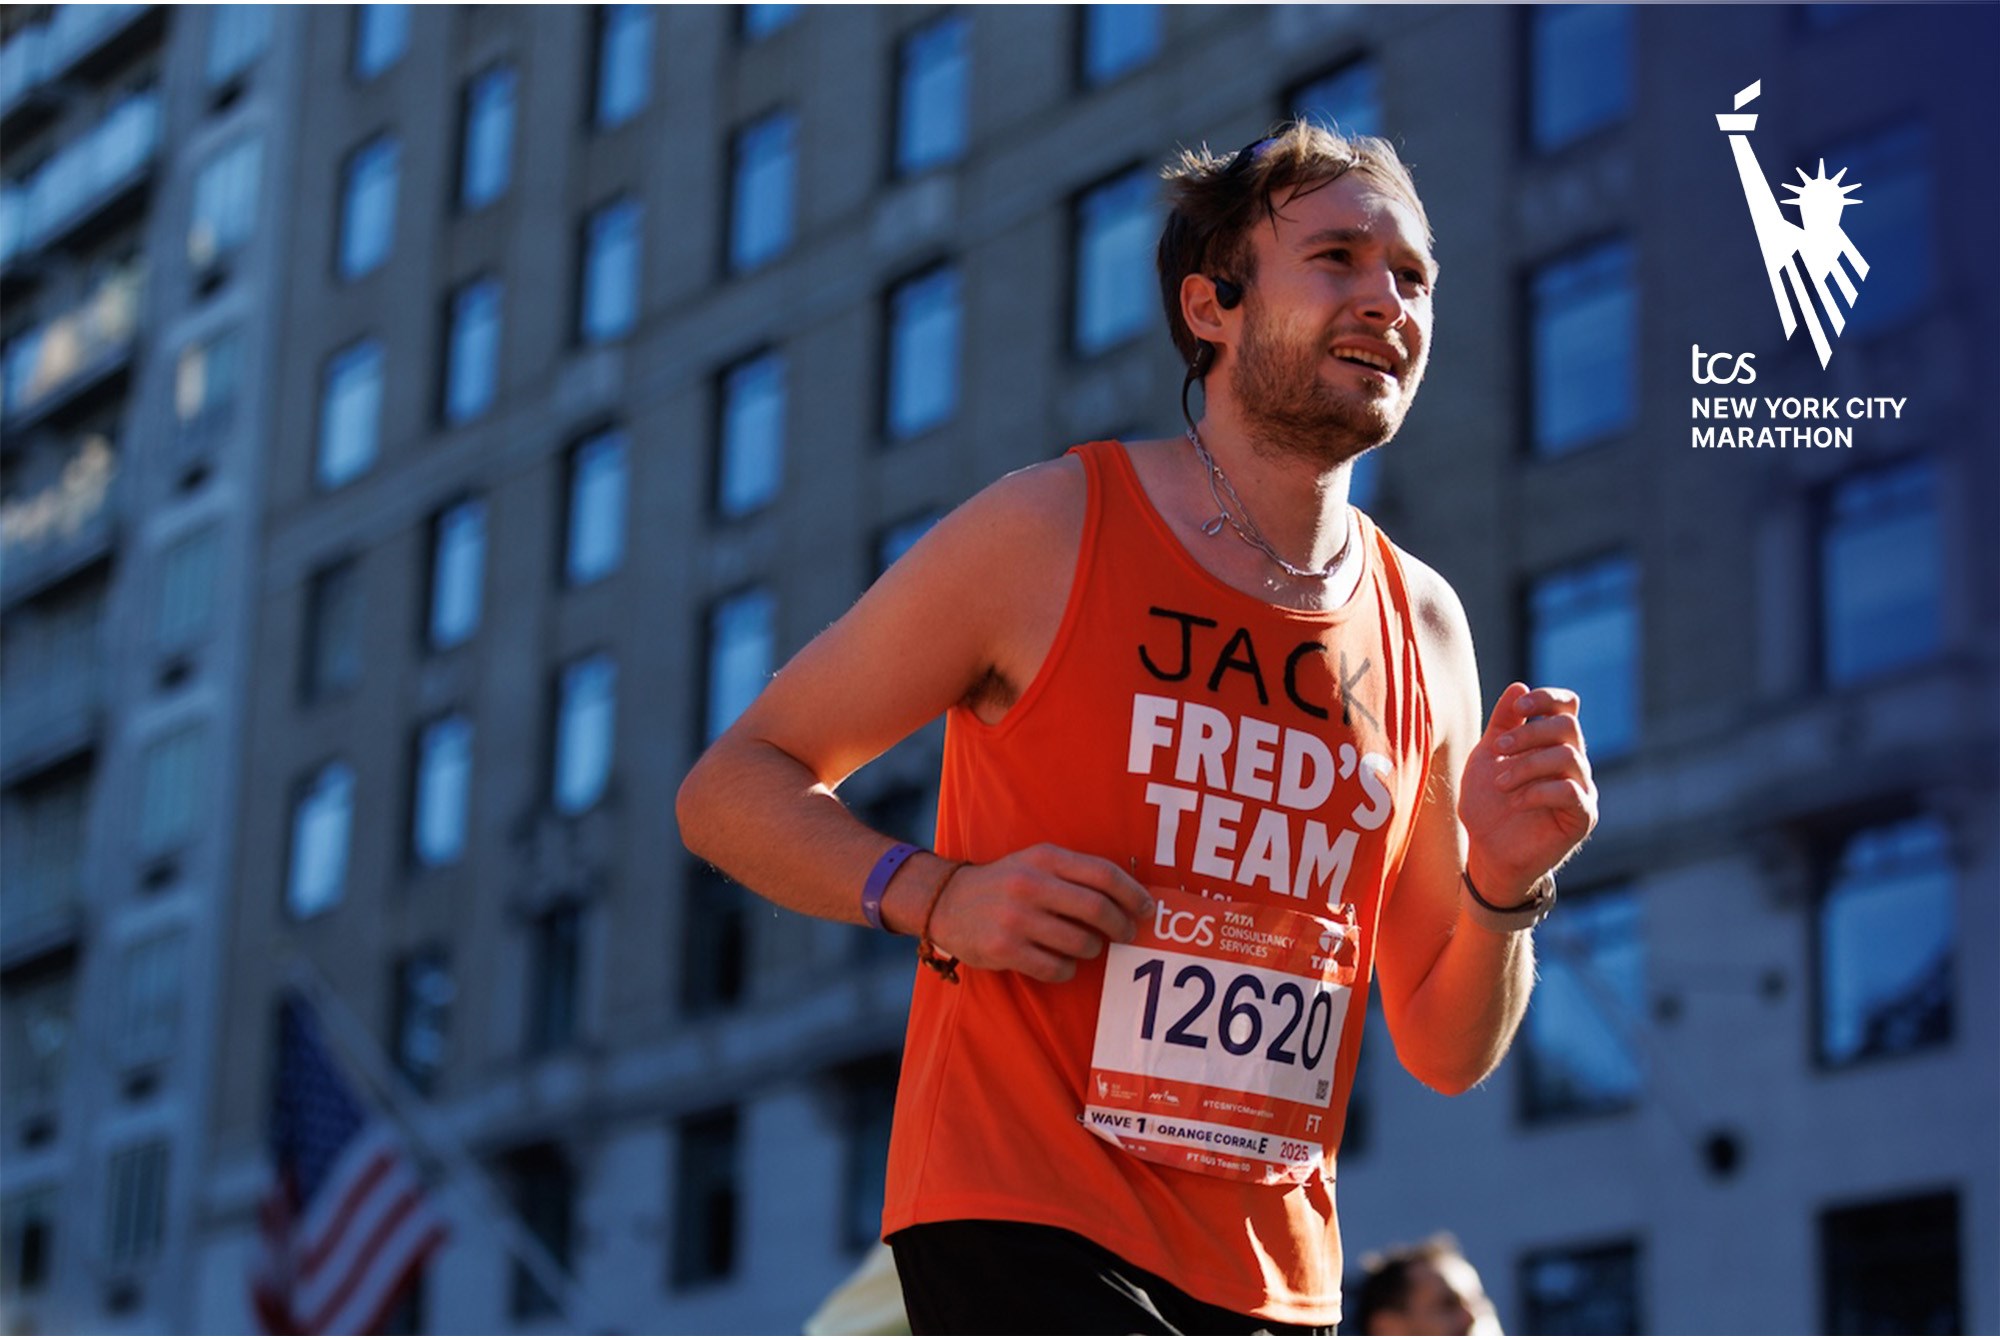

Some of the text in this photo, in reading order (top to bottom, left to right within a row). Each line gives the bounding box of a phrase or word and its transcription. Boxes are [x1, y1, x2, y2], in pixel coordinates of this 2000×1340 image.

[1137, 605, 1380, 733] JACK
[1144, 782, 1360, 908] TEAM
[1153, 899, 1216, 948] tcs
[1220, 924, 1296, 949] CONSULTANCY
[1223, 911, 1255, 928] TATA
[1219, 938, 1269, 959] SERVICES
[1310, 954, 1339, 975] TATA
[1132, 958, 1332, 1071] 12620
[1091, 1111, 1310, 1162] WAVE 1 ORANGE CORRAL E 2025
[1305, 1113, 1323, 1134] FT
